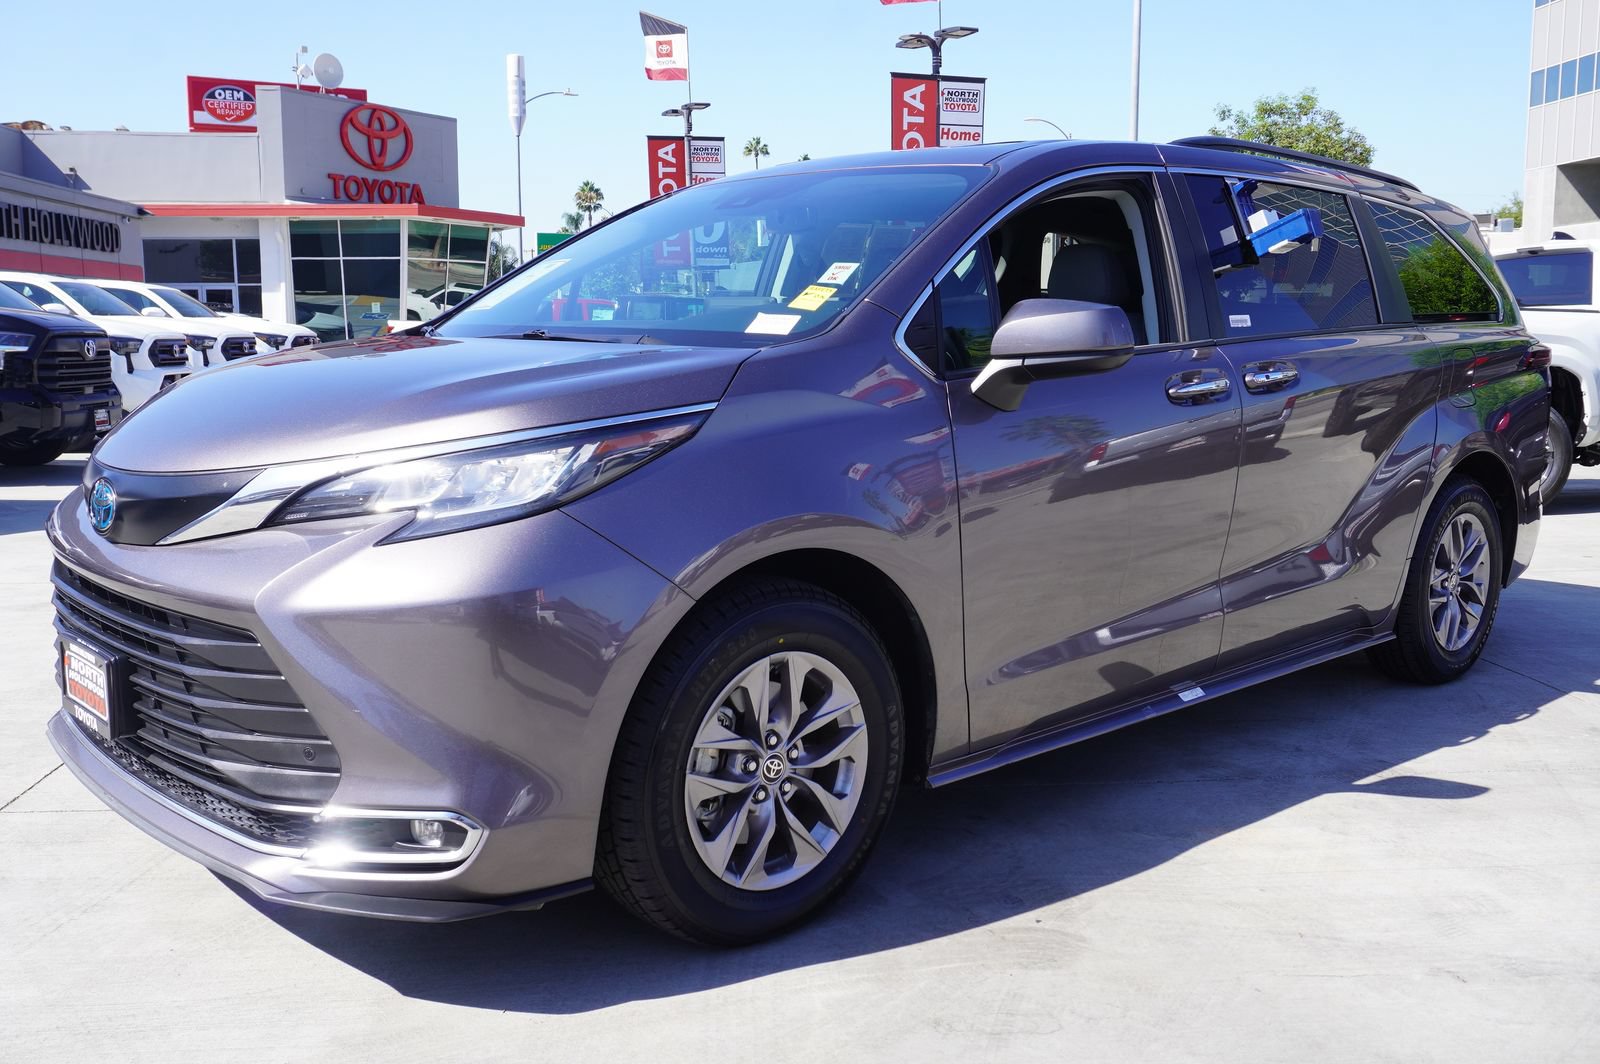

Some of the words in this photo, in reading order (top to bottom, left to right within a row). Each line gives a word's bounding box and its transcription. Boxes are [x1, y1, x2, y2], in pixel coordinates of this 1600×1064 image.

[214, 88, 244, 101] OEM
[944, 96, 978, 104] HOLLYWOOD
[946, 90, 979, 98] NORTH
[207, 100, 253, 111] CERTIFIED
[216, 107, 245, 117] REPAIRS
[944, 103, 977, 111] TOYOTA
[940, 127, 981, 142] Home
[327, 173, 426, 205] TOYOTA
[23, 206, 122, 253] HOLLYWOOD
[695, 245, 727, 253] down
[70, 655, 104, 687] NORTH
[68, 669, 105, 698] HOLLYWOOD
[68, 679, 107, 718] TOYOTA
[74, 704, 98, 731] TOYOTA
